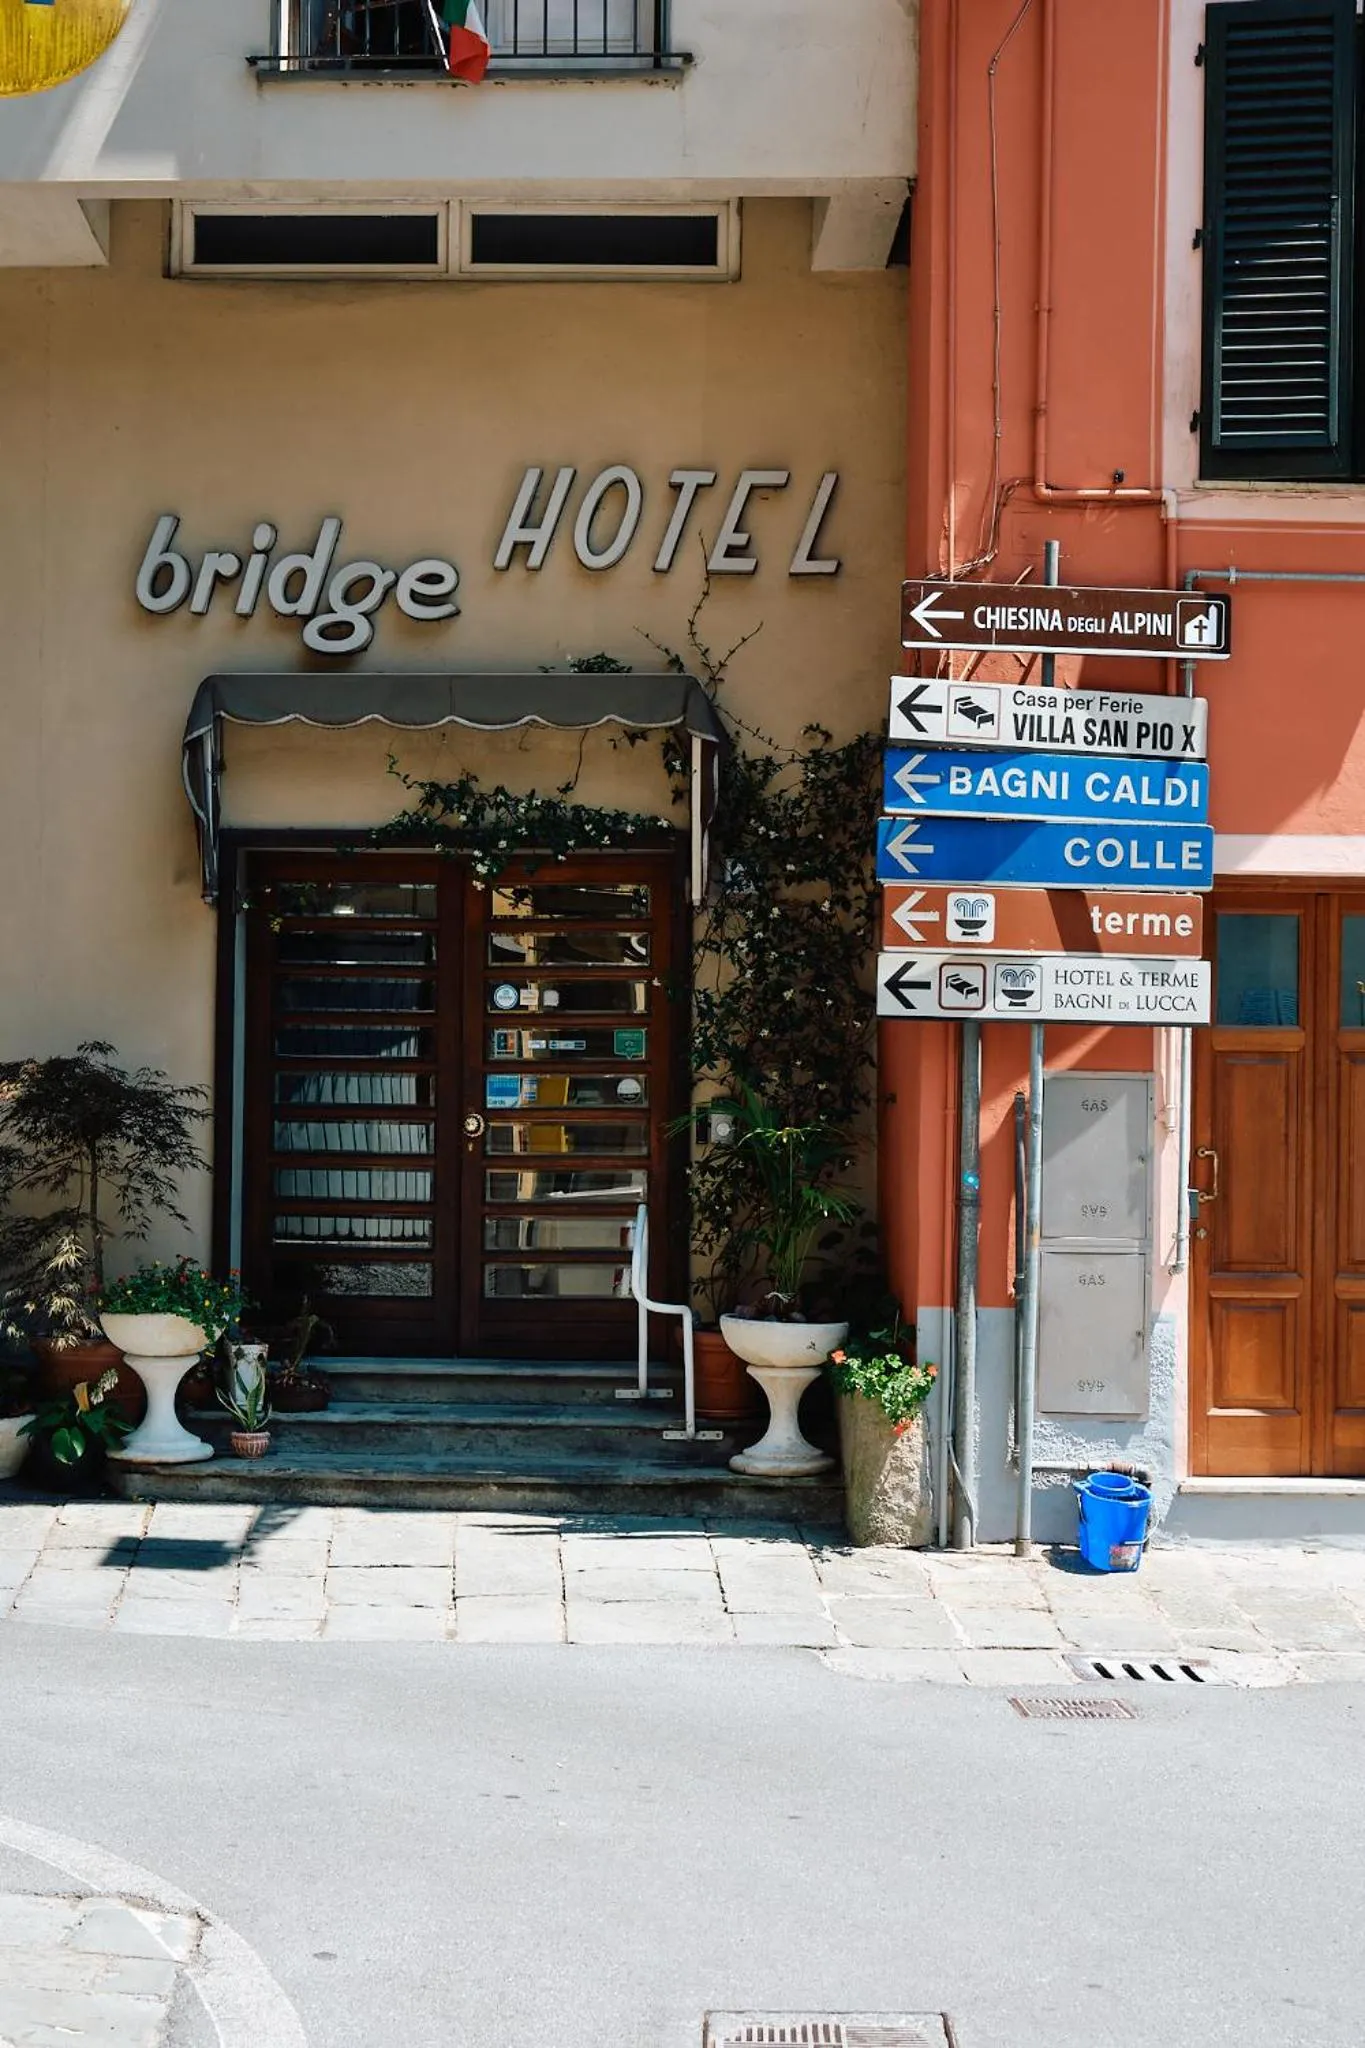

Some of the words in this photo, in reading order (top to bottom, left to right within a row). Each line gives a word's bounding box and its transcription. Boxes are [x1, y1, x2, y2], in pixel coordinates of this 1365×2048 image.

[135, 515, 462, 654] bridge
[494, 464, 842, 575] HOTEL
[973, 605, 1063, 632] CHIESINA
[1067, 616, 1105, 634] DEGLI
[1109, 612, 1172, 636] ALPINI
[1012, 690, 1058, 709] Casa
[1063, 696, 1094, 715] per
[1099, 696, 1144, 715] Ferie
[1012, 713, 1076, 744] VILLA
[1083, 718, 1128, 748] SAN
[1136, 721, 1174, 751] PIO
[1181, 724, 1197, 752] X
[949, 766, 1069, 801] BAGNI
[1085, 772, 1200, 808] CALDI
[1063, 837, 1204, 871] COLLE
[1090, 905, 1194, 936] terme
[1054, 969, 1115, 987] HOTEL
[1120, 974, 1133, 987] &
[1137, 972, 1200, 989] TERME
[1054, 993, 1112, 1010] BAGNI
[1136, 996, 1198, 1012] LUCCA
[1081, 1099, 1109, 1112] GAS
[1078, 1274, 1106, 1287] GAS
